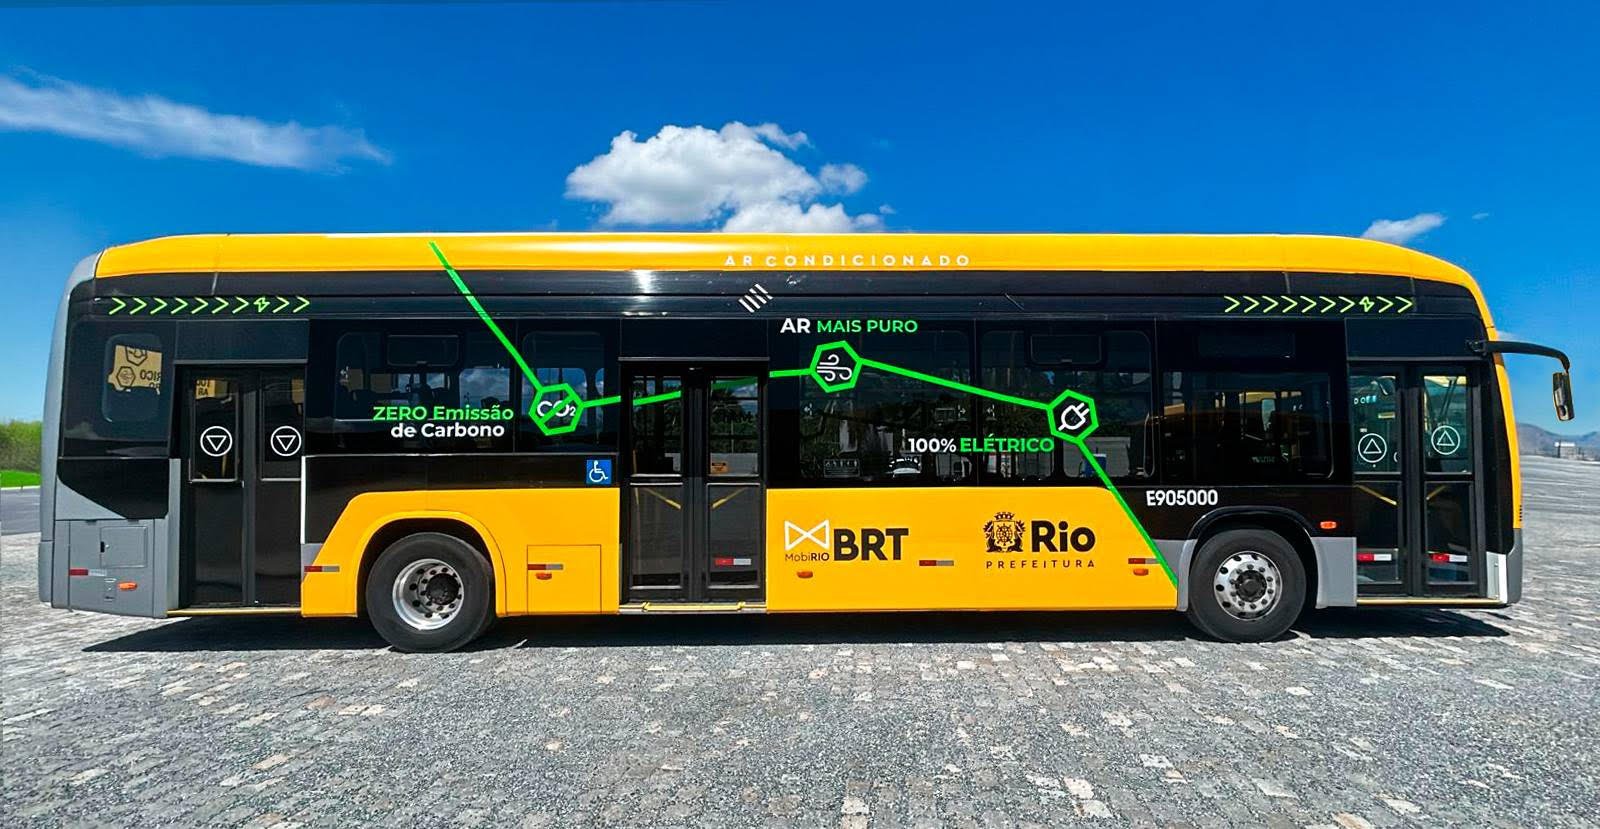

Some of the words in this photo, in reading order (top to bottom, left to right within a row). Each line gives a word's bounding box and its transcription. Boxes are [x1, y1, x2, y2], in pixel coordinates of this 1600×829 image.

[724, 255, 752, 266] AR
[765, 255, 970, 267] CONDICIONADO
[780, 318, 811, 333] AR
[816, 320, 862, 333] MAIS
[867, 320, 919, 333] PURO
[373, 407, 427, 420] ZERO
[433, 405, 514, 421] Emissão
[391, 423, 417, 437] de
[421, 423, 505, 437] Carbono
[908, 438, 957, 453] 100%
[960, 434, 1055, 453] ELÉTRICO
[1146, 490, 1218, 506] E905000
[1031, 520, 1096, 552] Rio
[834, 528, 909, 561] BRT
[785, 552, 829, 562] MobiRIO
[986, 560, 1096, 569] PREFEITURA
